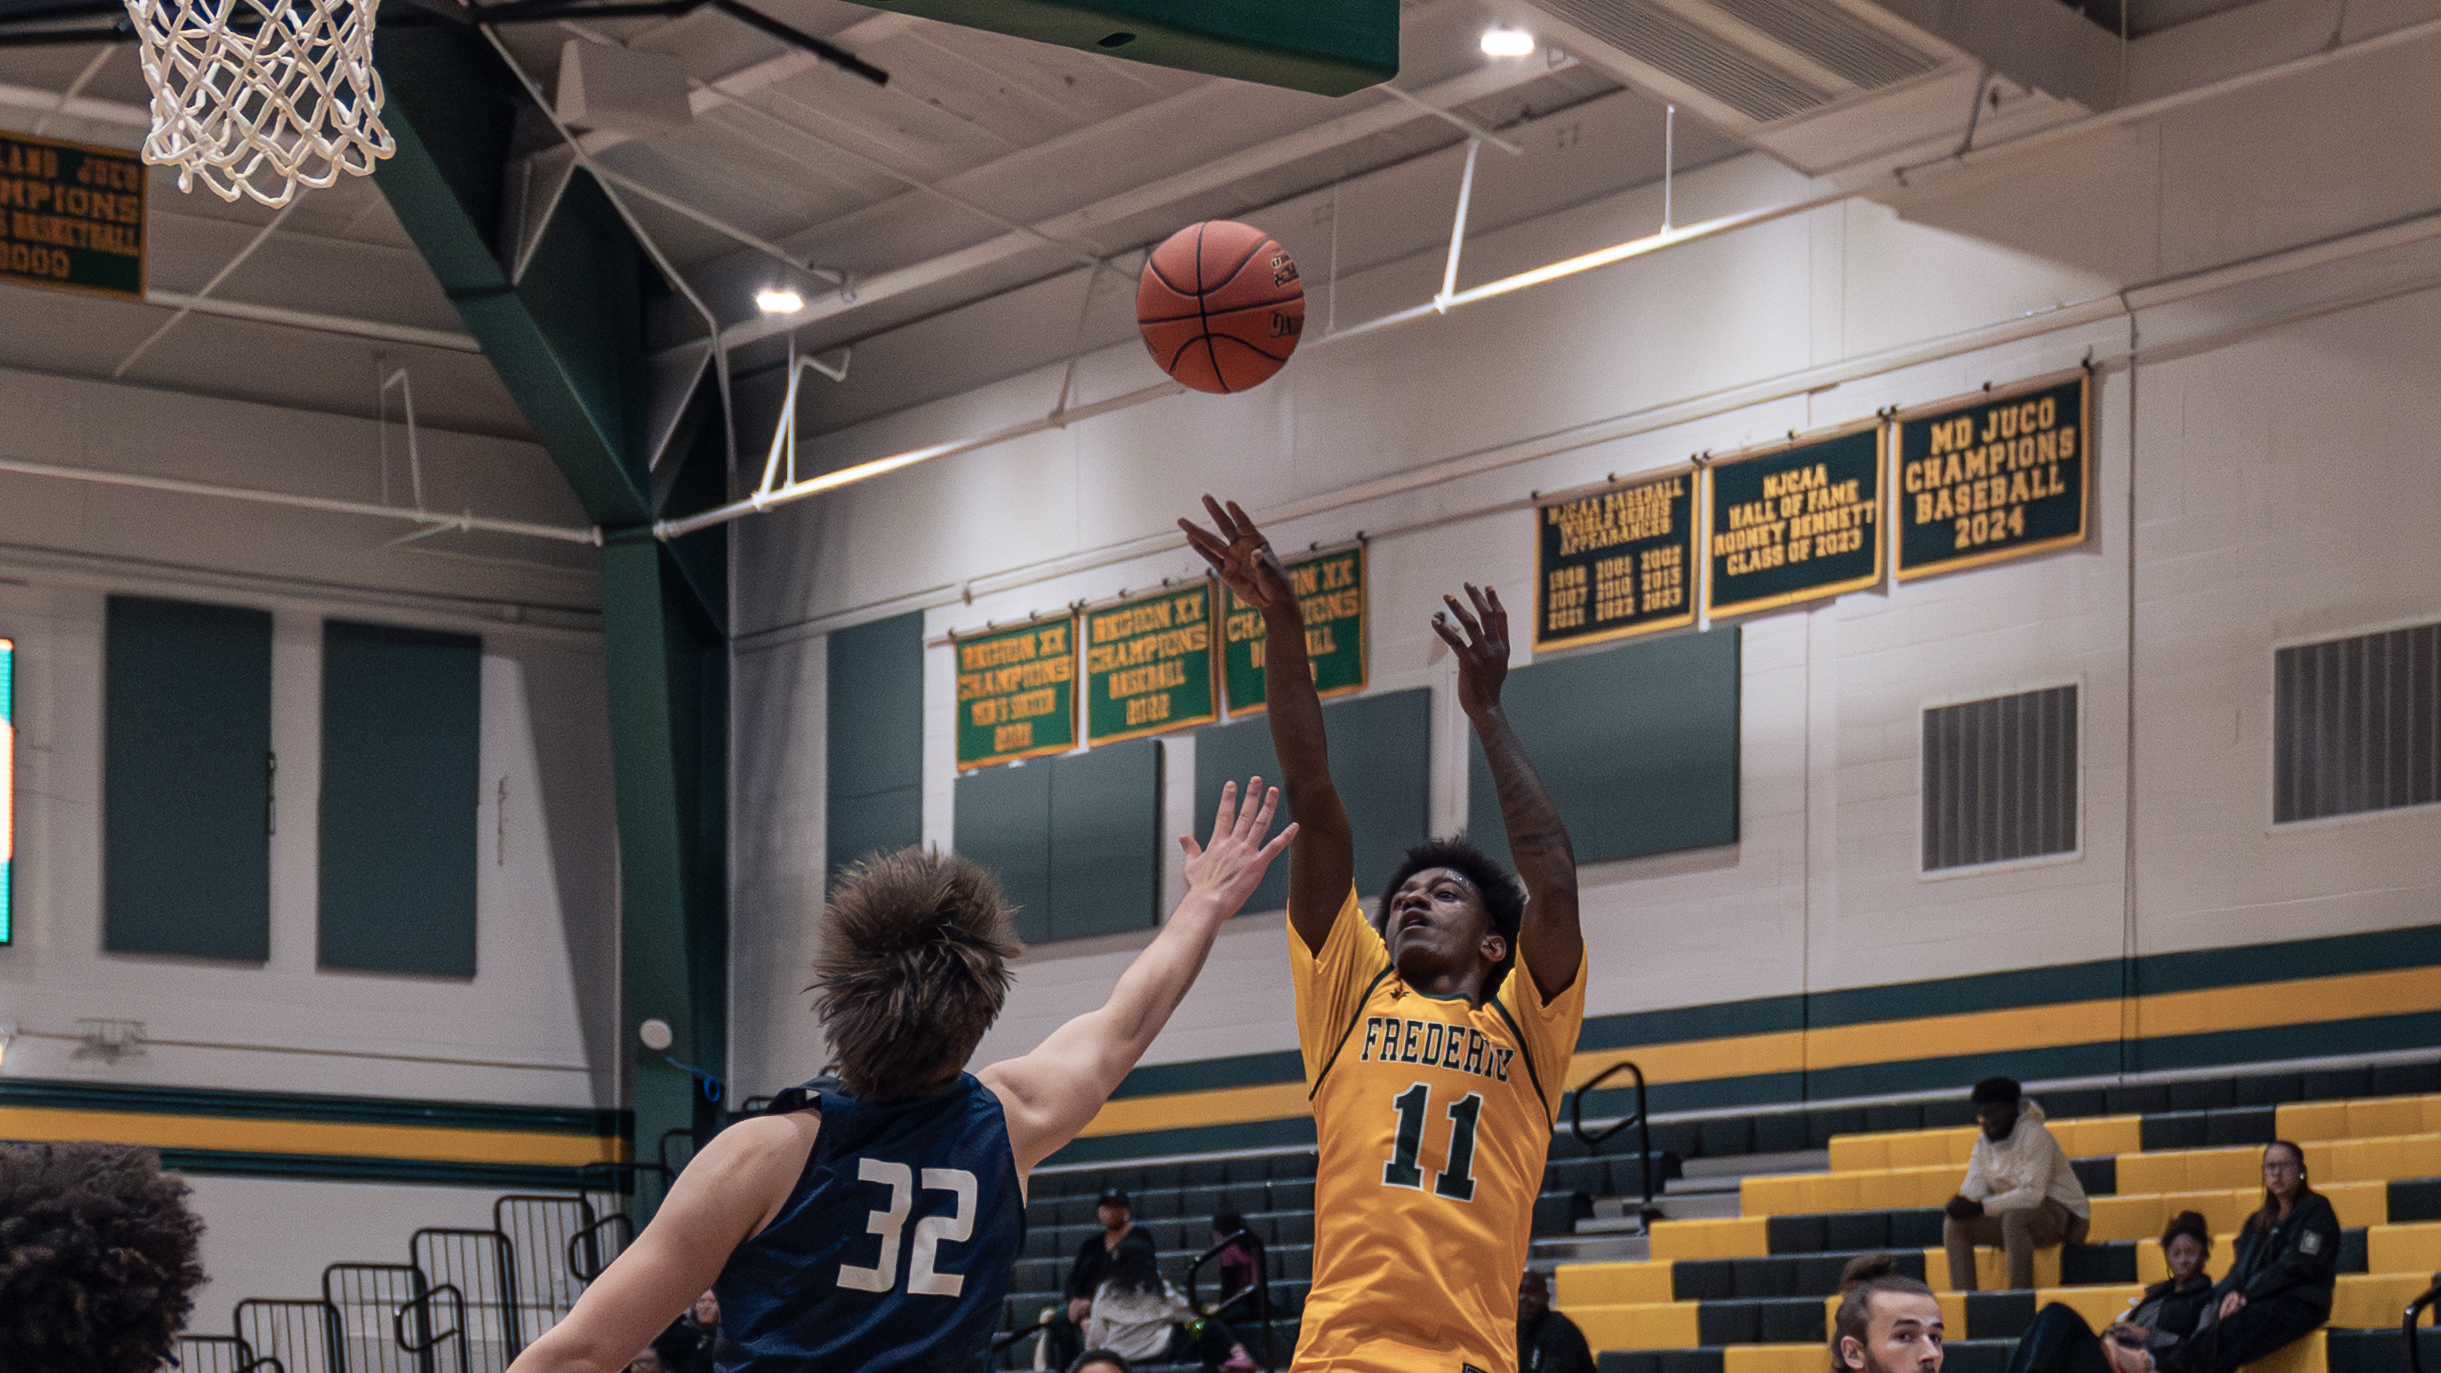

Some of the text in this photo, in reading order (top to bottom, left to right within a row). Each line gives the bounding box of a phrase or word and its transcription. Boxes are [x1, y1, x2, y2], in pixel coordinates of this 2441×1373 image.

[0, 144, 58, 179] AND
[1931, 396, 2055, 455] MD JUCO
[1763, 463, 1828, 500] NJCAA
[1906, 426, 2075, 494] CHAMPIONS
[1729, 479, 1859, 531] HALL OF FAME
[1916, 464, 2065, 525] BASEBALL
[1714, 500, 1875, 557] RODNEY BENNETT
[1727, 528, 1863, 576] CLASS OF 2023
[1955, 505, 2025, 549] 2024
[1087, 622, 1207, 674] CHAMPIONS
[1381, 1081, 1483, 1203] 11
[836, 1157, 978, 1297] 32
